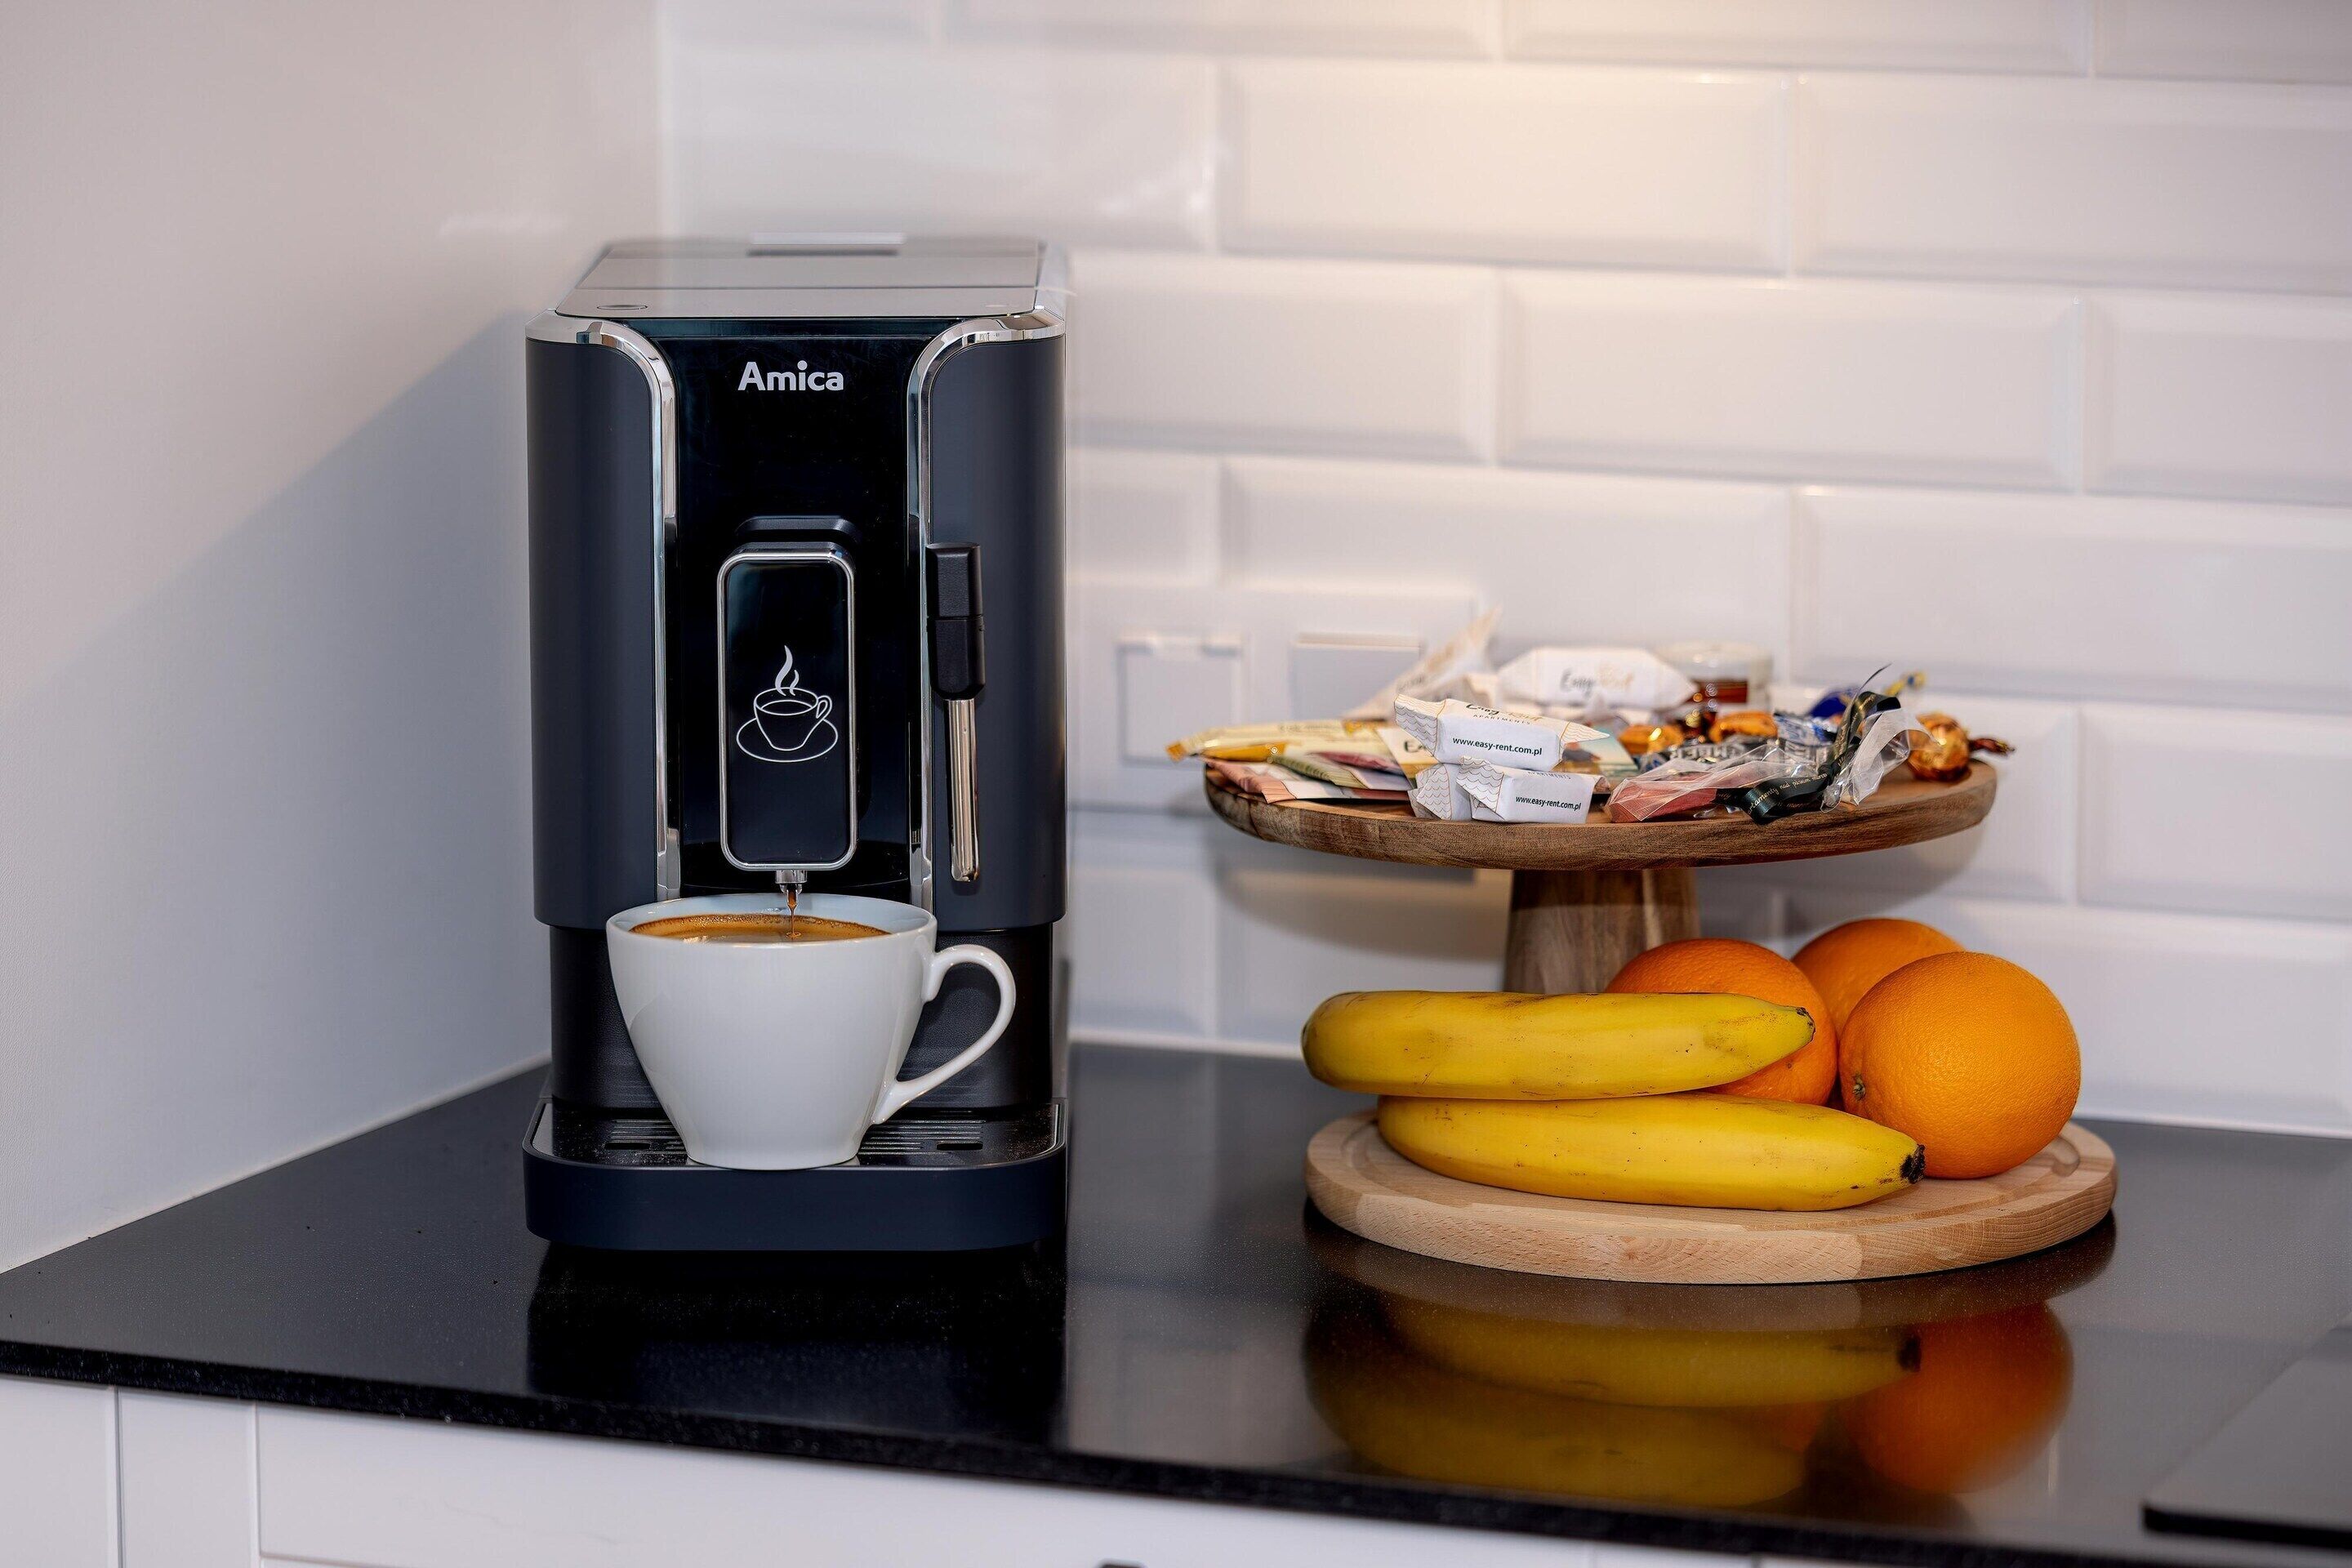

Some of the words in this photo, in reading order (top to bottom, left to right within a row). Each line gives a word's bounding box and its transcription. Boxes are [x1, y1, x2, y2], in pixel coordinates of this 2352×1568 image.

[737, 359, 844, 391] Amica
[1452, 737, 1543, 756] www.easy-rent.com.pl
[1515, 795, 1582, 812] www.easy-rent.com.pl
